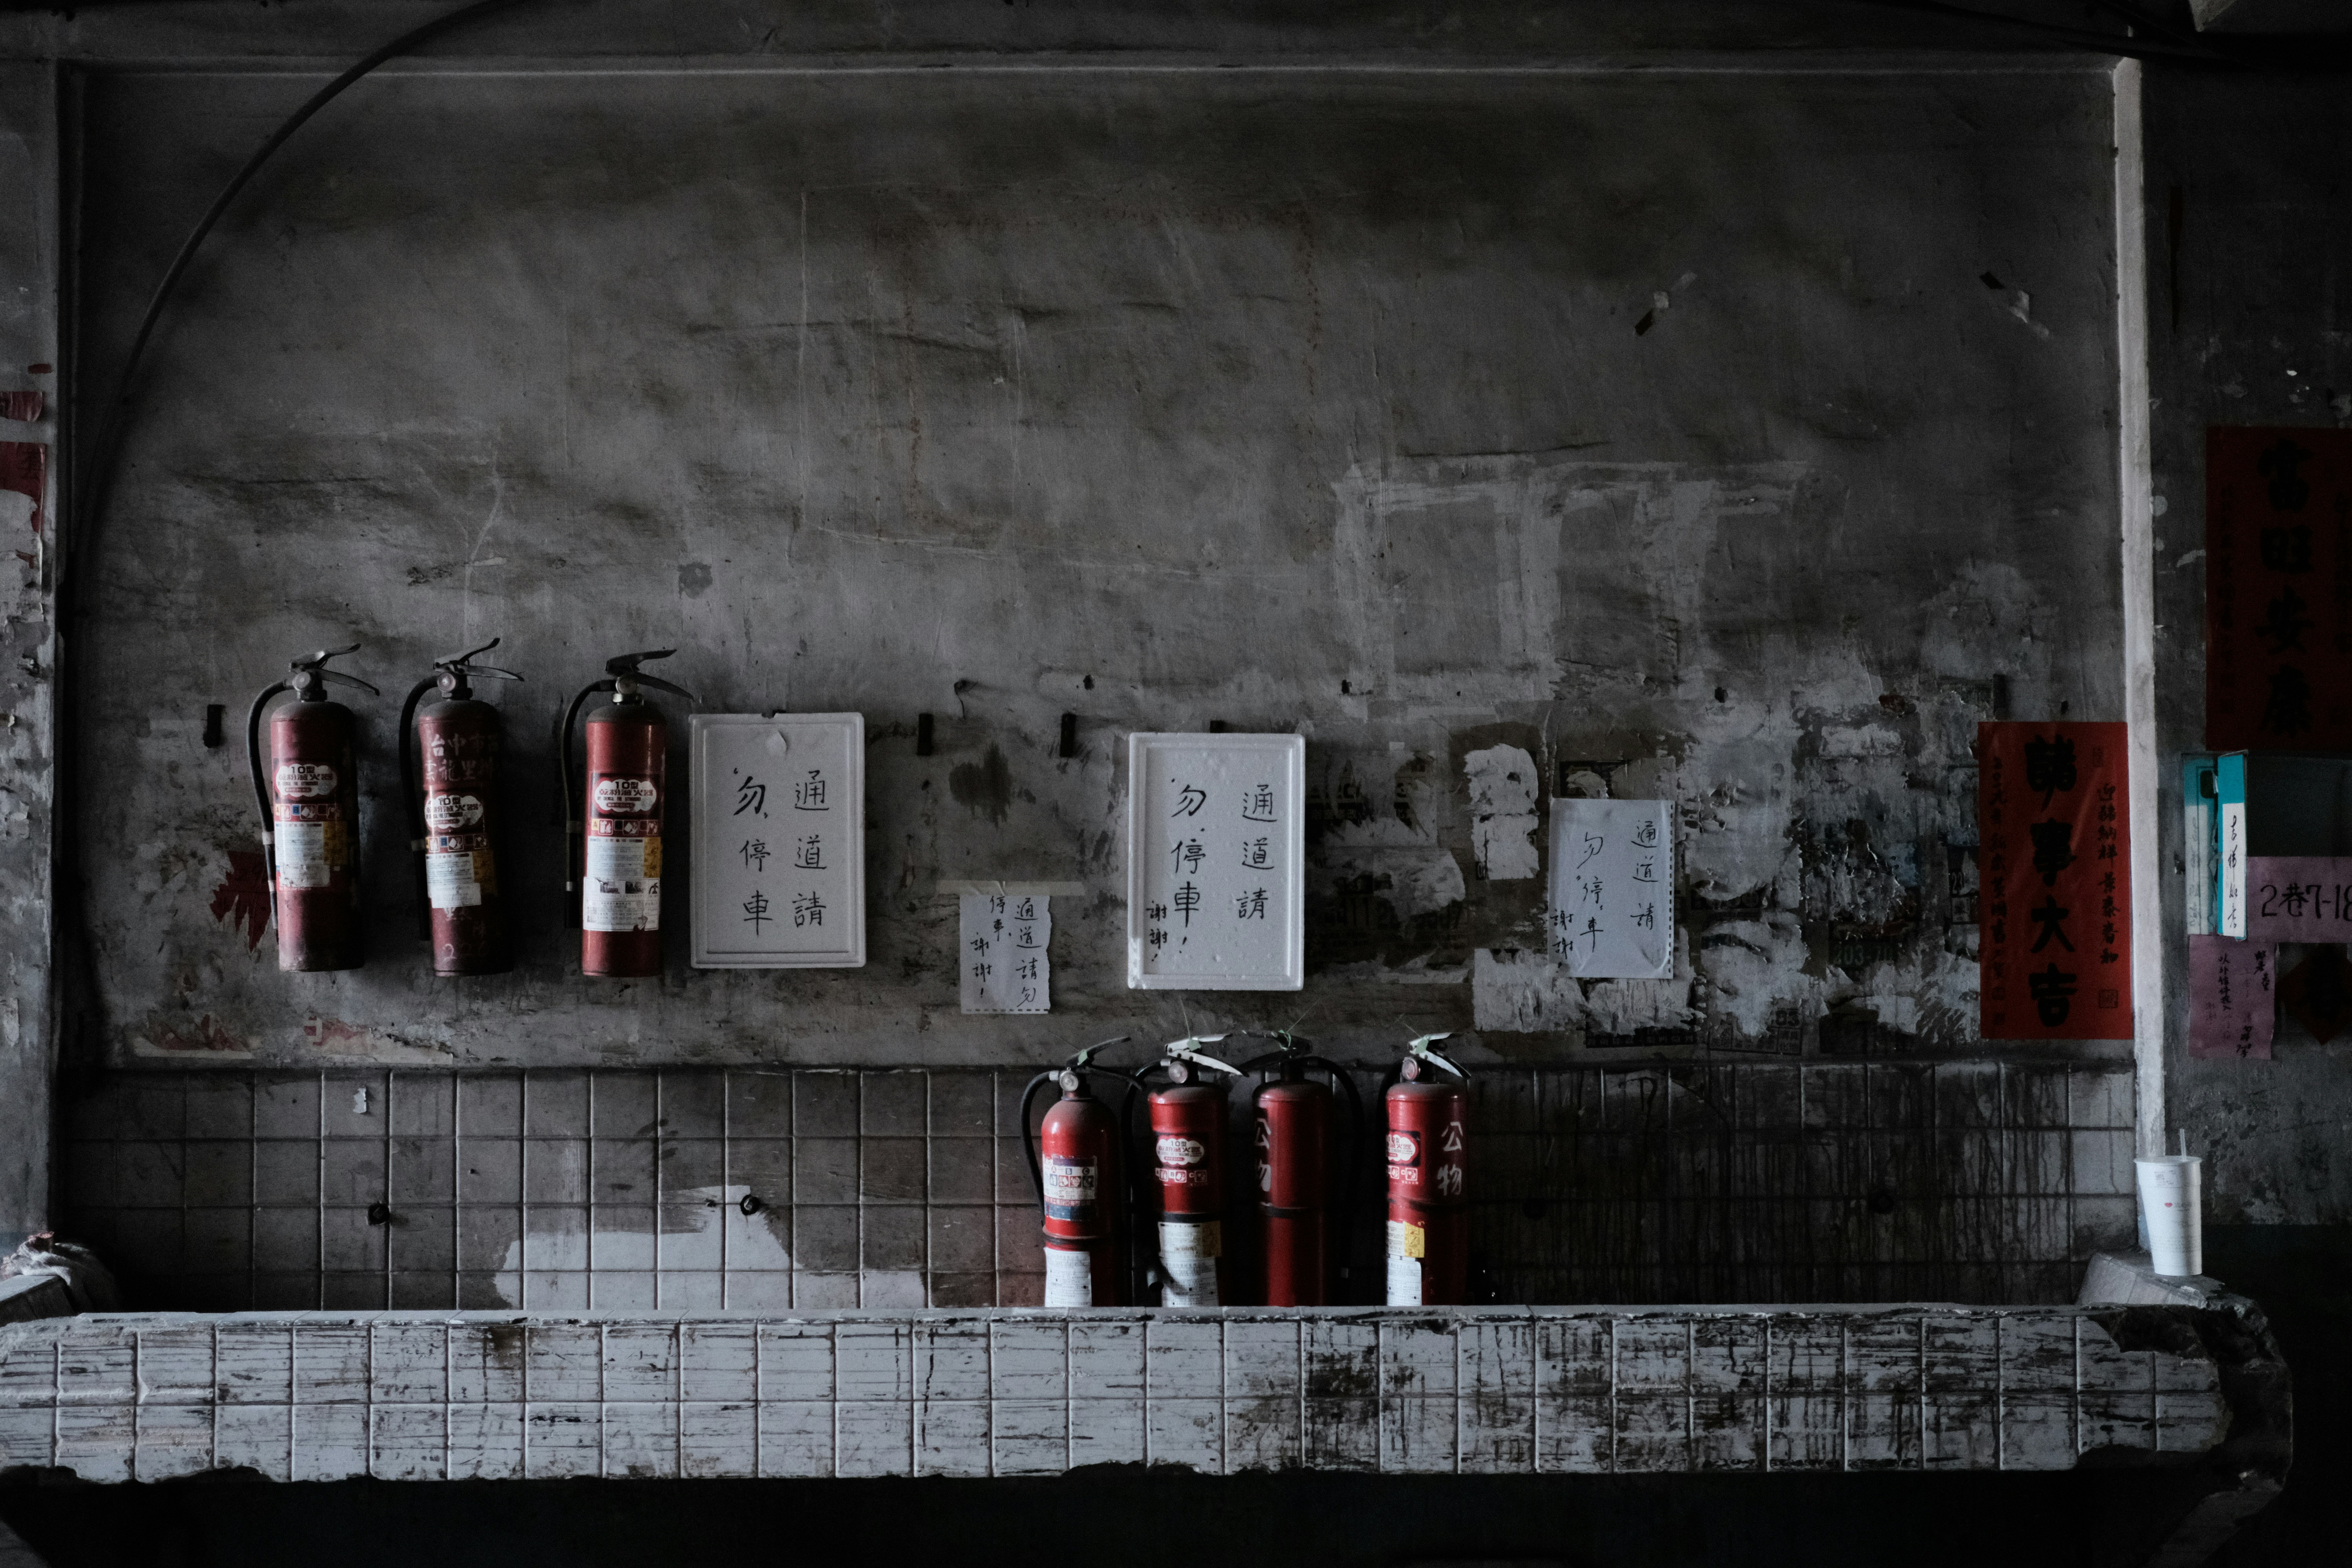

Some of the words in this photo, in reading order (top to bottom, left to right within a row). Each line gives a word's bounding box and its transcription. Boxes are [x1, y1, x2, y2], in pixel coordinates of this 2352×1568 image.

[792, 770, 829, 928] 通道請
[1237, 784, 1277, 920] 通道請
[1631, 821, 1659, 930] 通道請
[1436, 1121, 1464, 1197] 公物
